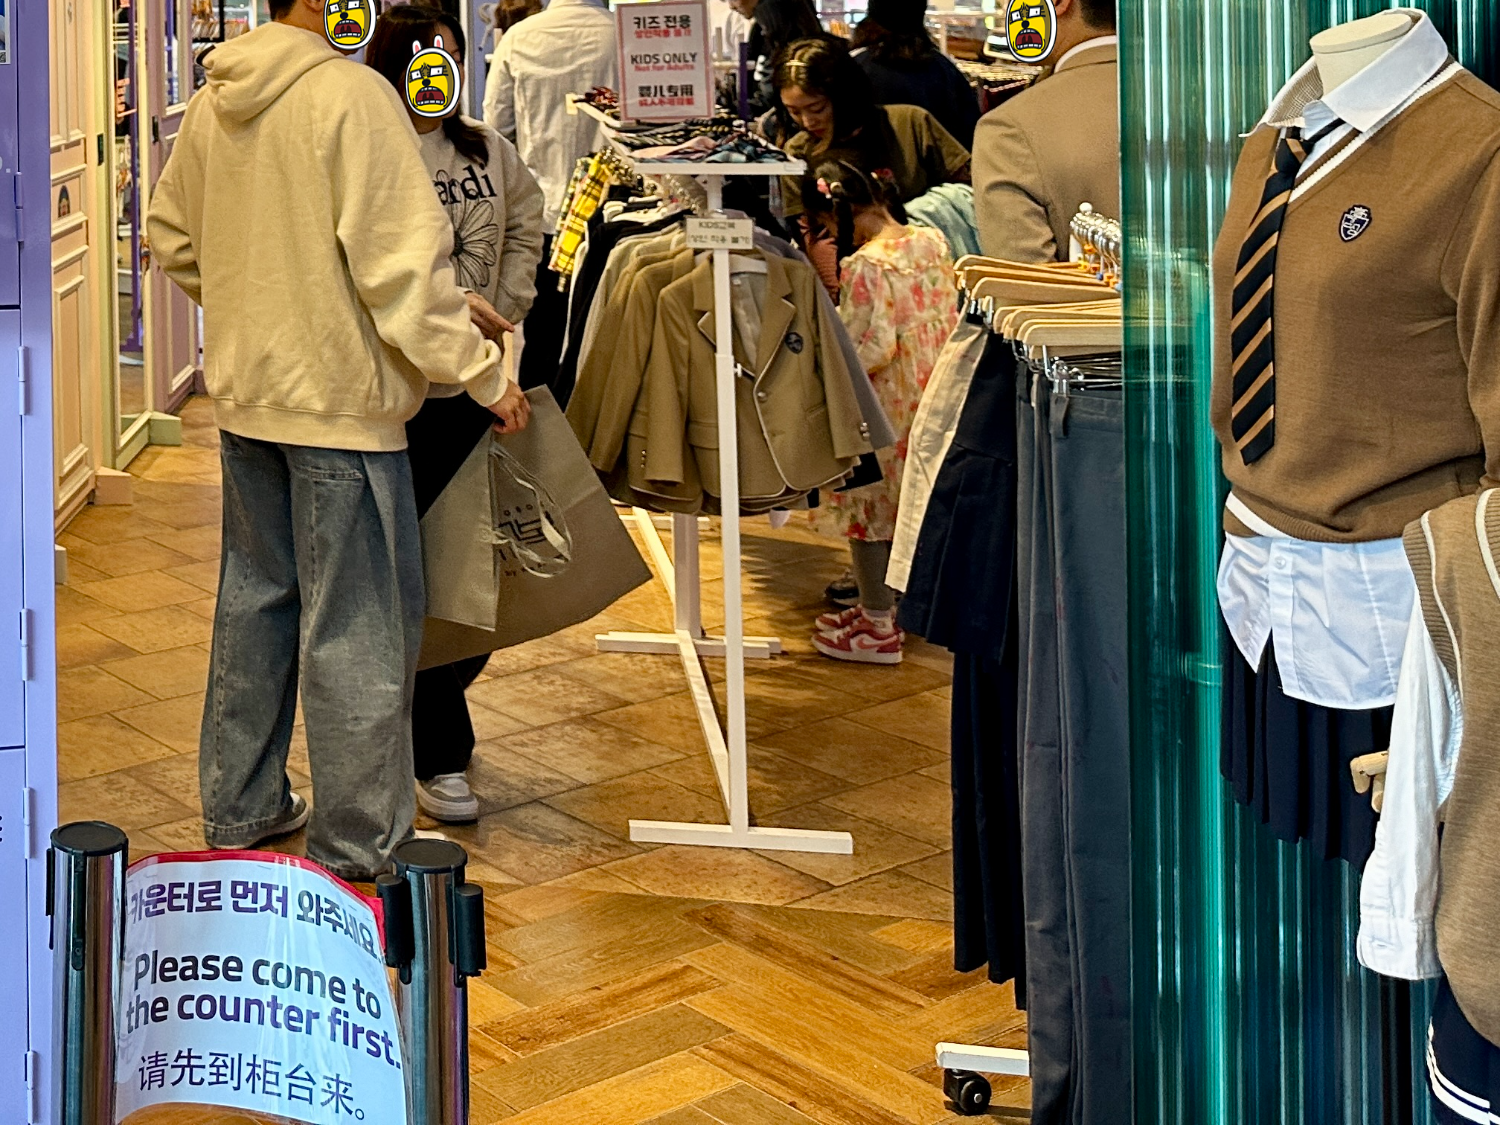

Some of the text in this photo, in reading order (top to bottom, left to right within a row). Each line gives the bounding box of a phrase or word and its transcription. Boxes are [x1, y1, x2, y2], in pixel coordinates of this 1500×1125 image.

[633, 15, 691, 29] 키즈 전용
[631, 52, 697, 64] KIDS ONLY
[432, 164, 497, 206] ardi
[131, 879, 222, 924] 카운터로
[230, 880, 288, 918] 먼저
[134, 949, 382, 1020] Please come to
[126, 993, 401, 1070] the counter first.
[138, 1047, 366, 1122] 请先到柜台来。
